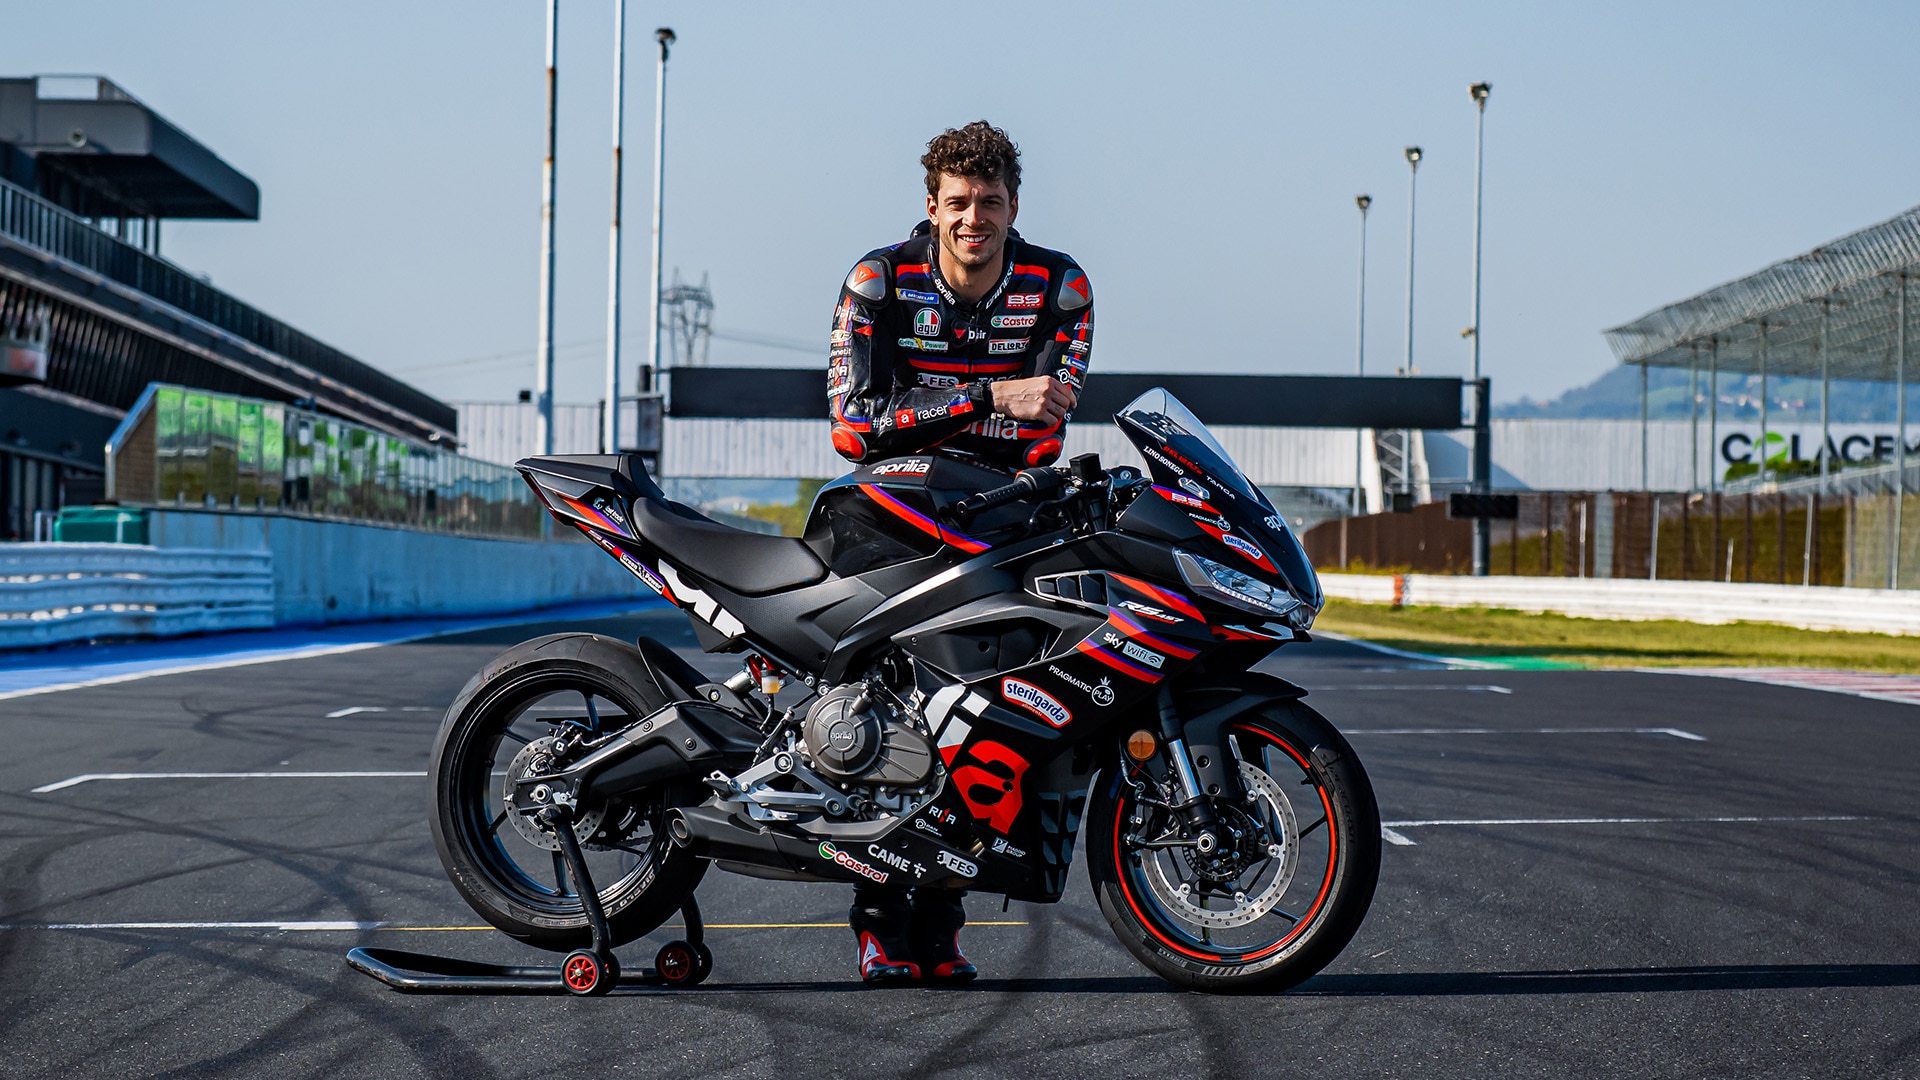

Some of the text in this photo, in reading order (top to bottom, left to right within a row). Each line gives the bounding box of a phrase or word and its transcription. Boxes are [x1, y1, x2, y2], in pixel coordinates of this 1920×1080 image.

[934, 278, 956, 306] aprilia
[1007, 294, 1041, 304] BS
[918, 325, 937, 335] agv
[925, 341, 946, 349] Power
[929, 377, 955, 387] FES
[917, 404, 948, 420] racer
[971, 413, 1018, 440] rilia
[872, 459, 931, 476] aprilia
[1143, 445, 1184, 476] LINO SONEGO
[1206, 475, 1236, 500] TARGA
[1224, 535, 1260, 558] sterilgarda
[622, 554, 662, 589] Green Power
[1118, 600, 1164, 616] RS
[1103, 632, 1148, 659] sky wifi
[1048, 665, 1113, 703] PRAGMATIC PLAY
[1006, 682, 1066, 722] sterilgarda
[834, 849, 889, 884] Castrol
[867, 844, 912, 872] CAME
[948, 858, 974, 875] FES
